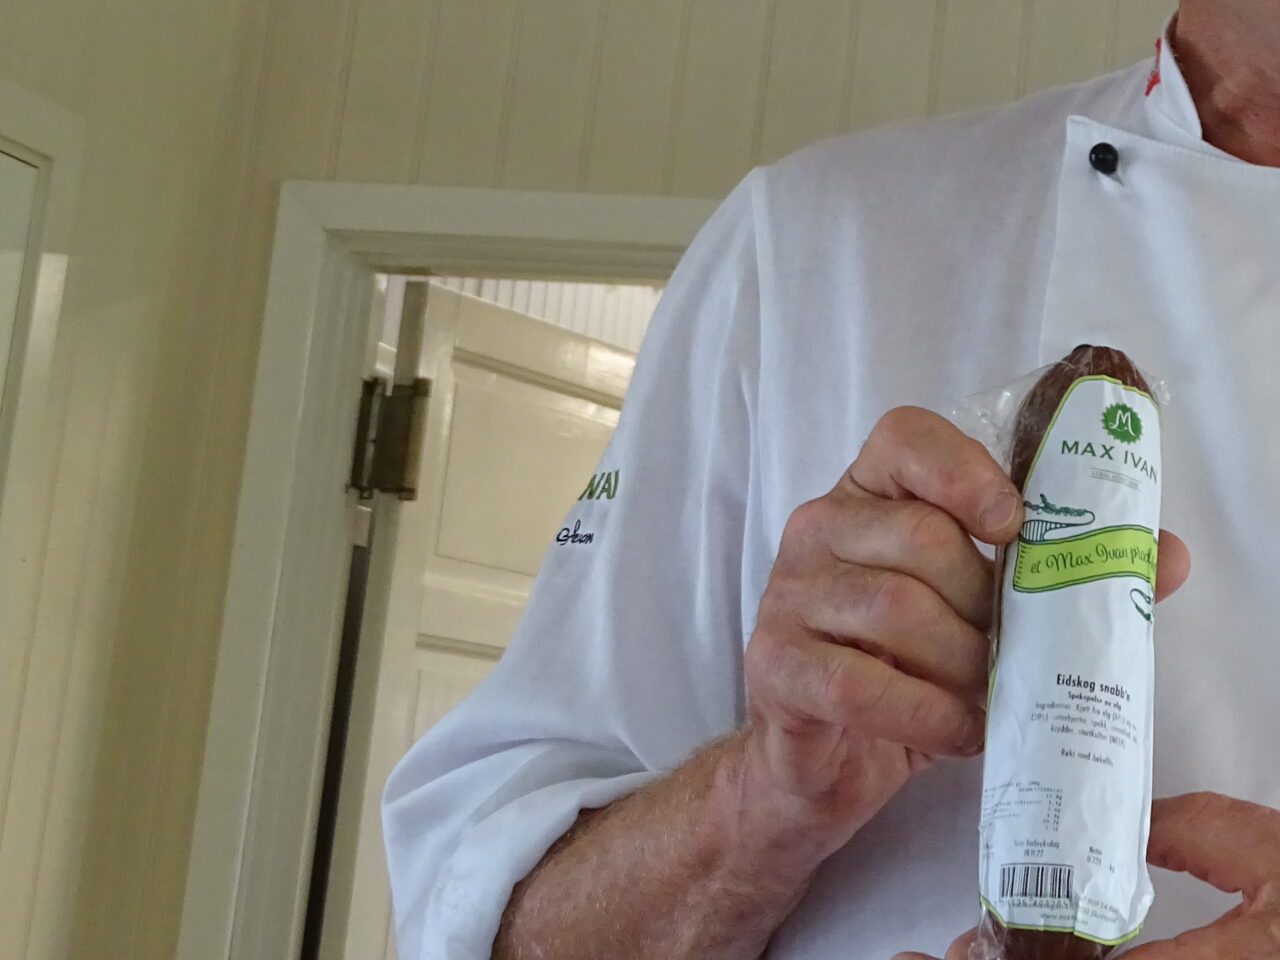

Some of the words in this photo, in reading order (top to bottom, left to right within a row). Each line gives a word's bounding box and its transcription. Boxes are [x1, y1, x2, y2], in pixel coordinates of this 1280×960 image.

[1061, 439, 1115, 461] MAX
[1123, 450, 1157, 485] IVAN
[1045, 551, 1094, 572] Max
[1095, 542, 1128, 563] Ivan
[1056, 673, 1096, 693] Eidskog
